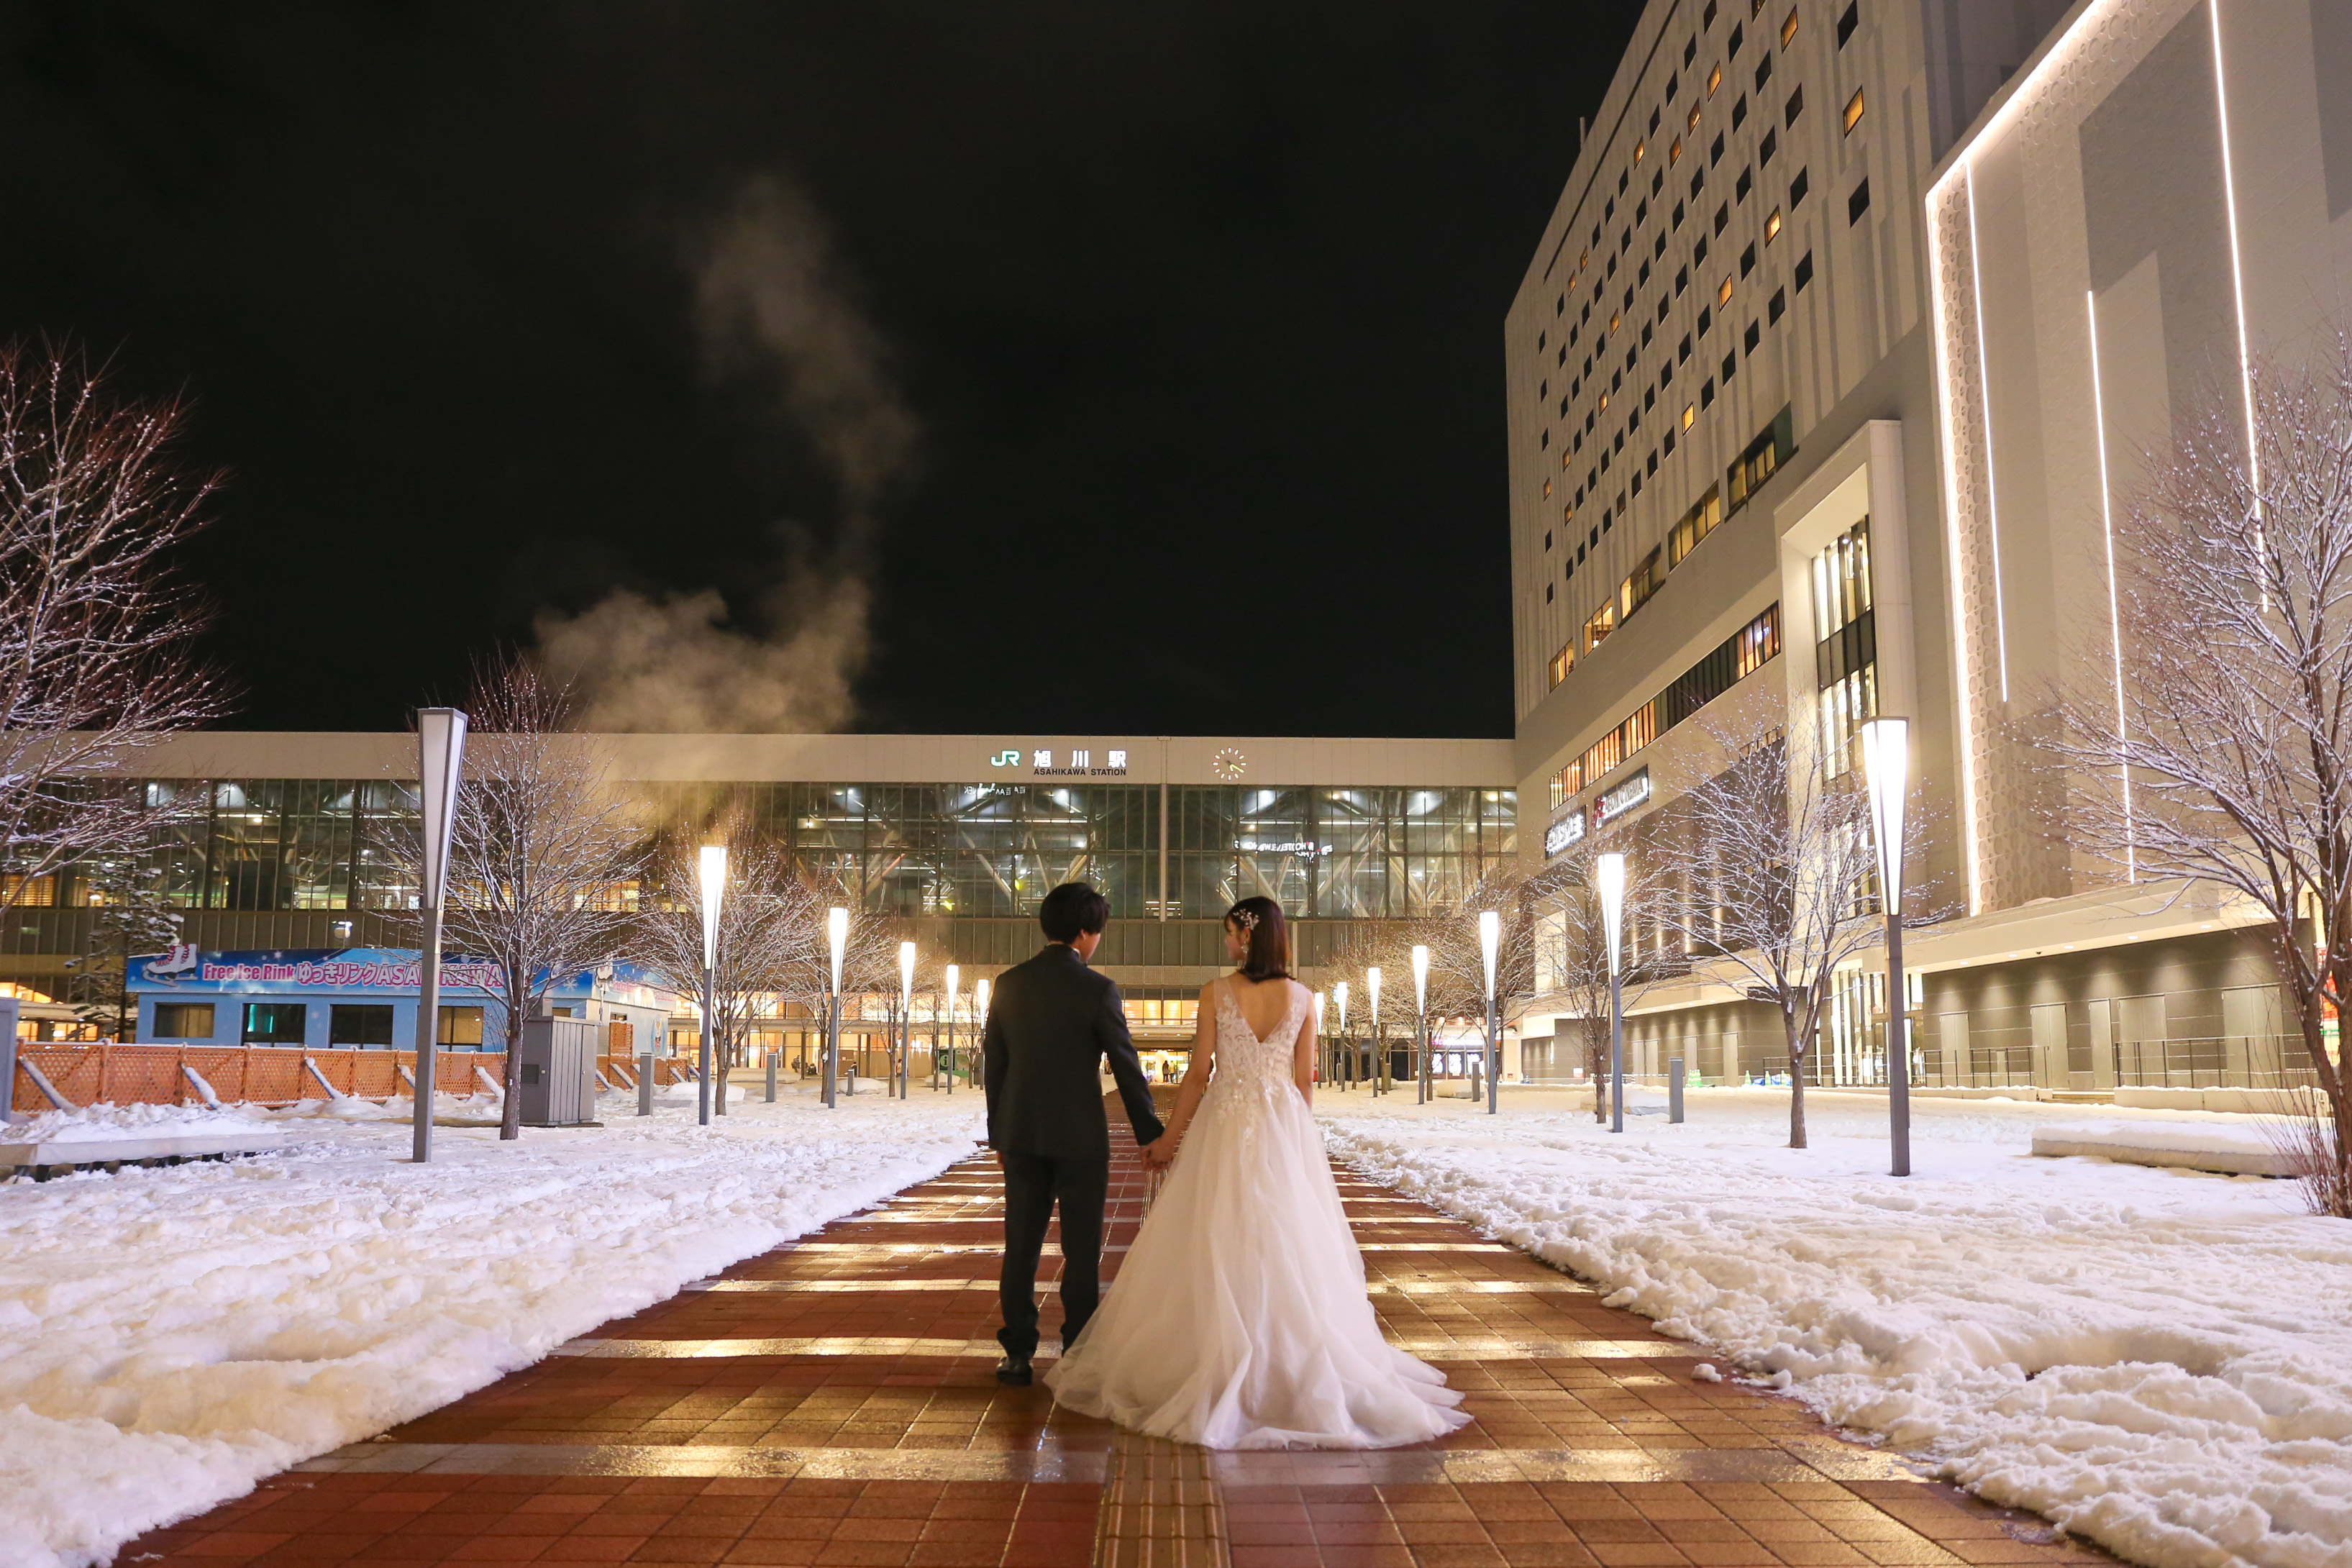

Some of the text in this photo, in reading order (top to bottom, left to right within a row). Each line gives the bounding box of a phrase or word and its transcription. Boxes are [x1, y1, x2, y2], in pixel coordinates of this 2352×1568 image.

[990, 749, 1021, 767] JR
[1033, 749, 1126, 767] 旭川駅
[204, 964, 234, 980] Free
[236, 964, 260, 980] Ice
[262, 964, 295, 980] Rink
[375, 964, 504, 988] ASAKAWA
